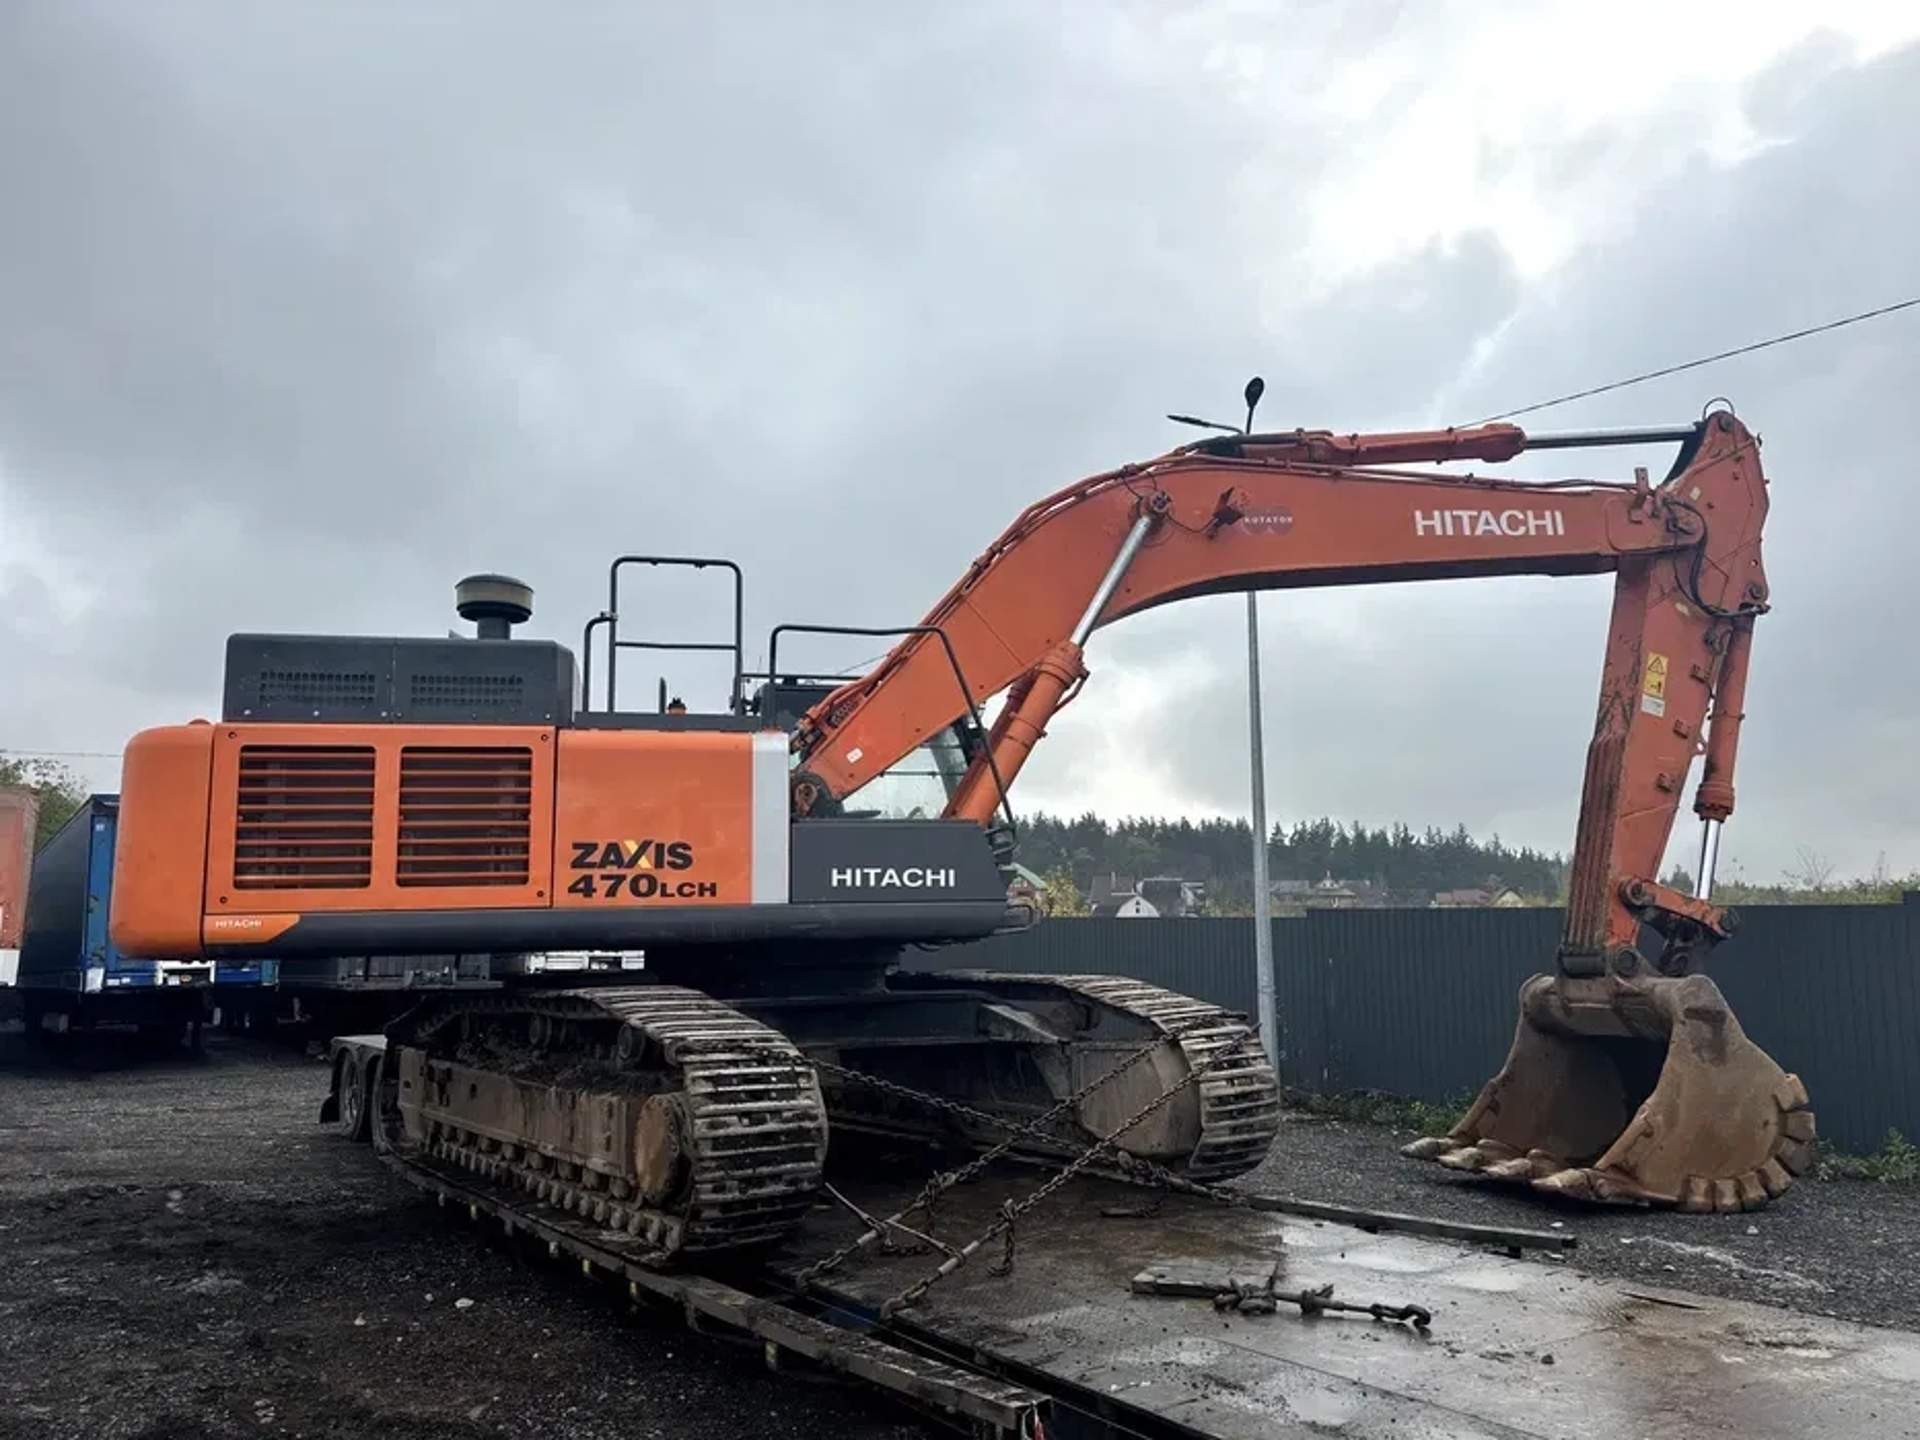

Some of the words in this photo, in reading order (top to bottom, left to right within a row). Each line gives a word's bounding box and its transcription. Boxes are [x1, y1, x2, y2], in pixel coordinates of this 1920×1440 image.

[1414, 509, 1565, 536] HITACHI
[571, 840, 693, 869] ZAXIS
[566, 874, 717, 898] 470LCH
[830, 867, 955, 887] HITACHI
[215, 918, 262, 929] HITACHI
